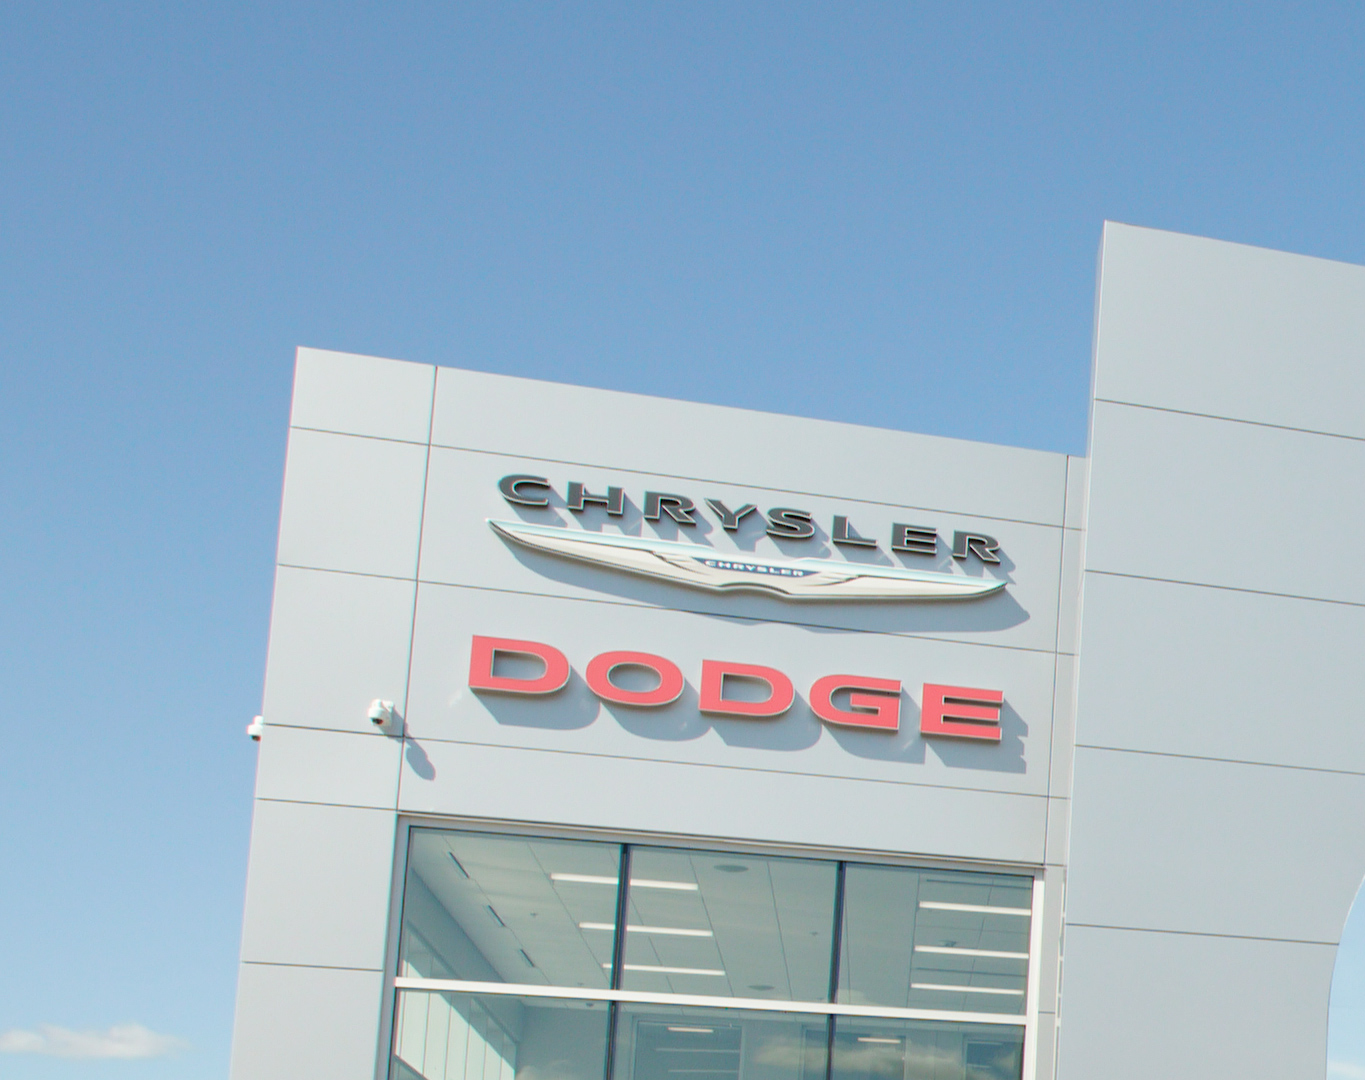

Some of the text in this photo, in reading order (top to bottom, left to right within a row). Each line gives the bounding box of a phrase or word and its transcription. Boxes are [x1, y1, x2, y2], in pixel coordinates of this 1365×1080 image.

[496, 473, 1003, 565] CHRYSLER
[704, 559, 804, 577] CHRYSLER
[468, 634, 1004, 742] DODGE
